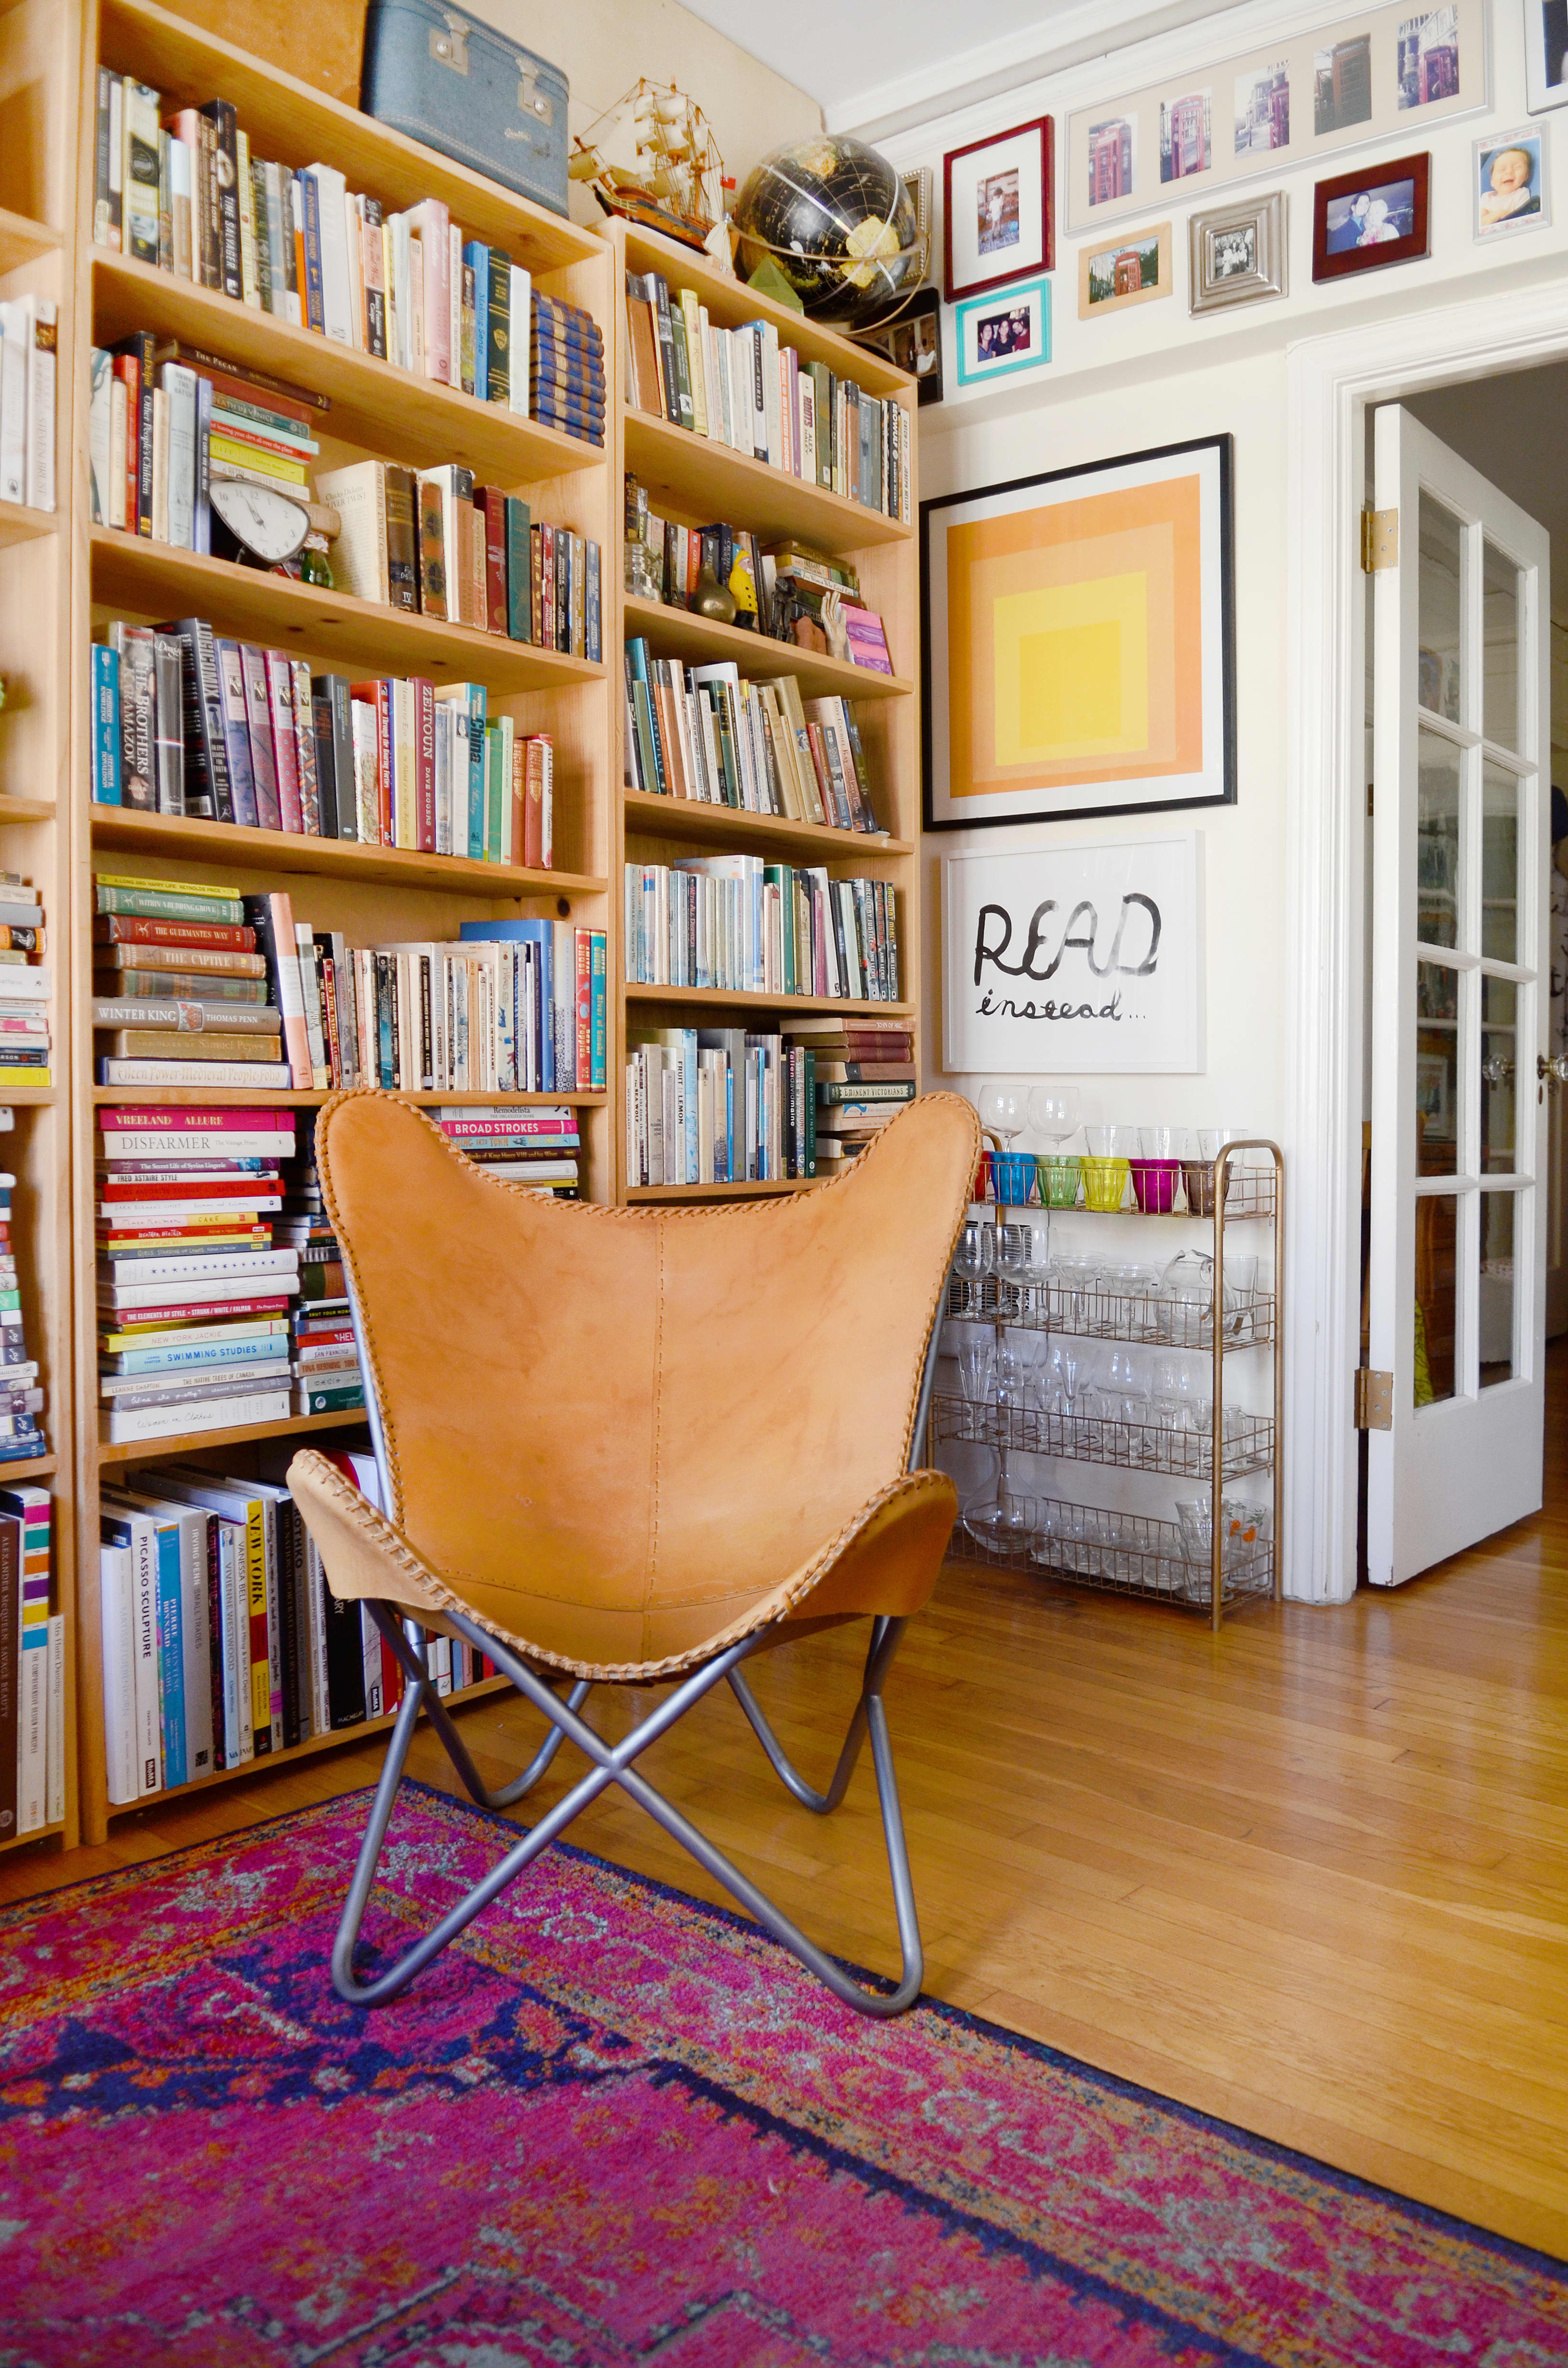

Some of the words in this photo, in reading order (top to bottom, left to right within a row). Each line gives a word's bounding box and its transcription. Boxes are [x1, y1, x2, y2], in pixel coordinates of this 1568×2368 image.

[224, 196, 234, 218] TIME
[225, 221, 236, 269] SALVAGER
[308, 231, 317, 261] LIBRARY
[143, 359, 152, 386] Delpit
[143, 395, 151, 421] Other
[803, 395, 813, 427] ROOTS
[141, 423, 151, 455] People's
[199, 623, 219, 698] LOGICOMIX
[135, 661, 149, 691] THE
[123, 668, 135, 765] KARAMAZOV
[423, 686, 432, 759] ZEITOUN
[135, 695, 149, 774] BROTHERS
[470, 718, 484, 763] China
[651, 703, 663, 774] HICKSVILLE
[139, 899, 159, 908] WITHIN
[195, 903, 216, 913] GROVE
[170, 928, 211, 937] GUERMANTES
[214, 930, 228, 939] WAY
[974, 893, 1161, 986] READ
[165, 952, 186, 963] THE
[192, 956, 230, 967] CAPTIVE
[98, 1007, 145, 1020] WINTER
[148, 1009, 177, 1021] KING
[844, 1088, 869, 1096] EMINENT
[116, 1116, 172, 1125] VREELAND
[184, 1117, 223, 1125] ALLURE
[455, 1124, 491, 1133] BROAD
[494, 1123, 538, 1133] STROKES
[122, 1137, 210, 1149] DISFARMER
[195, 1331, 221, 1340] JACKIE
[167, 1350, 217, 1361] SWIMMING
[220, 1345, 257, 1356] STUDIES
[135, 1383, 160, 1392] SHAPTON
[236, 1371, 255, 1380] CANADA
[249, 1514, 261, 1552] NEW
[140, 1536, 149, 1586] PICASSO
[251, 1556, 262, 1604] YORK
[142, 1591, 151, 1658] SCULPTURE
[226, 1611, 235, 1670] WESTWOOD
